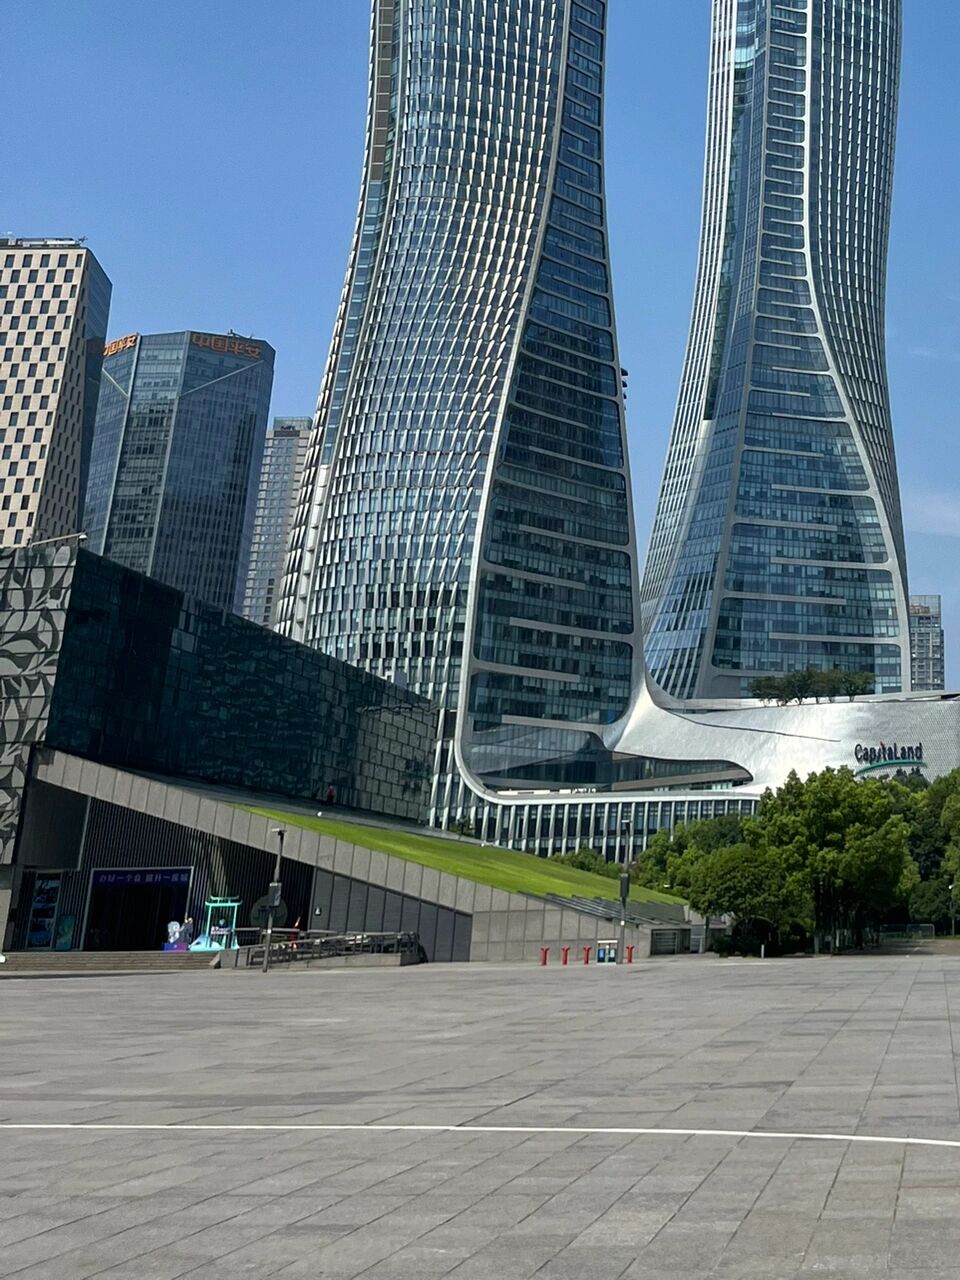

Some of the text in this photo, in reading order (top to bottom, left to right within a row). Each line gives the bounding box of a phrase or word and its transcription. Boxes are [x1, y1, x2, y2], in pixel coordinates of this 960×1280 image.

[192, 333, 261, 360] 中国平安
[854, 740, 923, 765] CapitaLand
